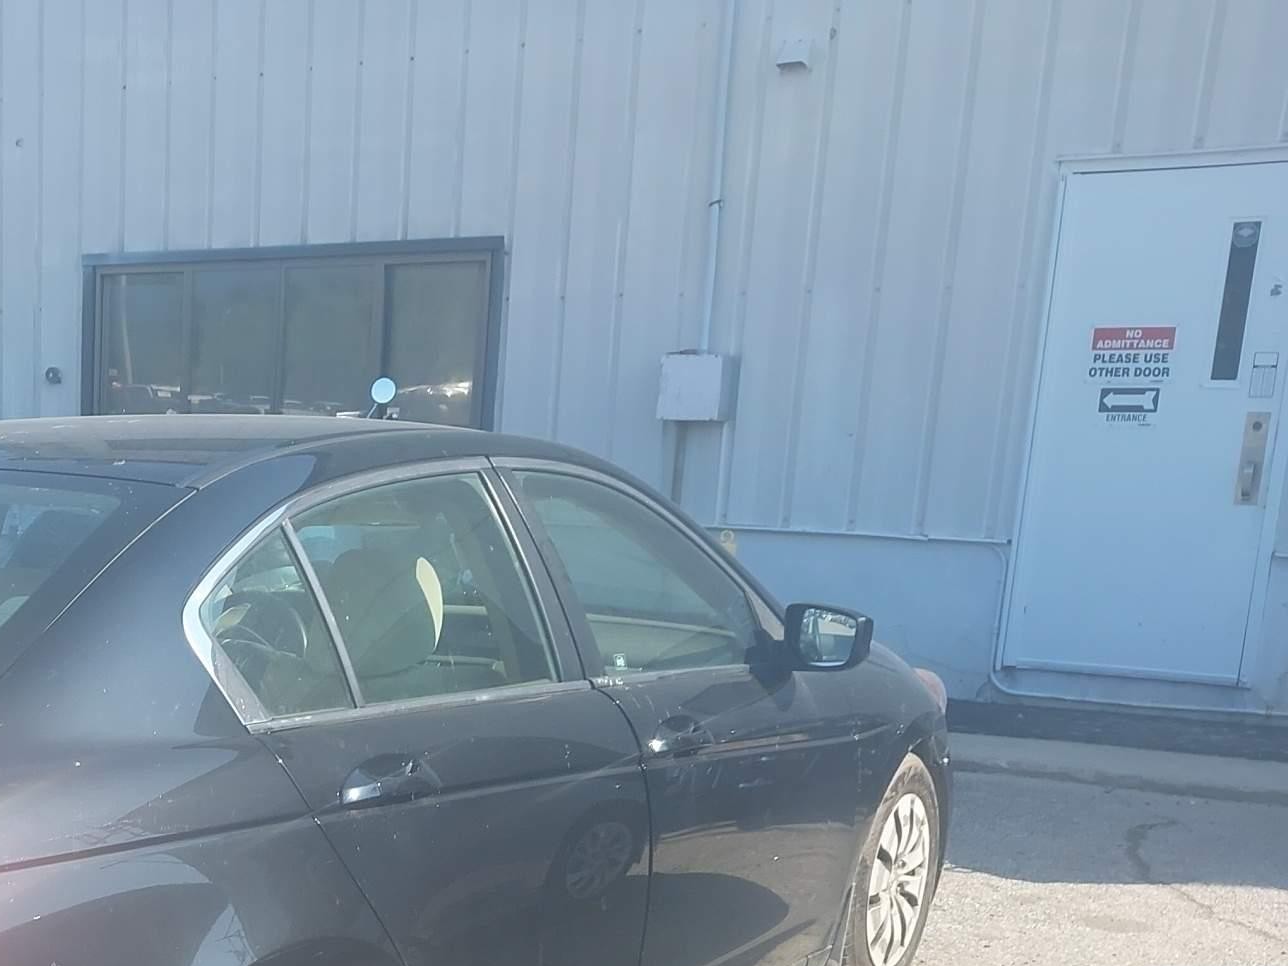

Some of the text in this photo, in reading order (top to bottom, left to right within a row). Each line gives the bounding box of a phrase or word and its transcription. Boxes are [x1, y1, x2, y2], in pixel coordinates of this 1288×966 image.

[1125, 329, 1143, 338] NO
[1096, 339, 1170, 349] ADMITTANCE
[1093, 352, 1169, 364] PLEASE USE
[1088, 367, 1170, 377] OTHER DOOR
[1105, 413, 1148, 422] ENTRANCE
